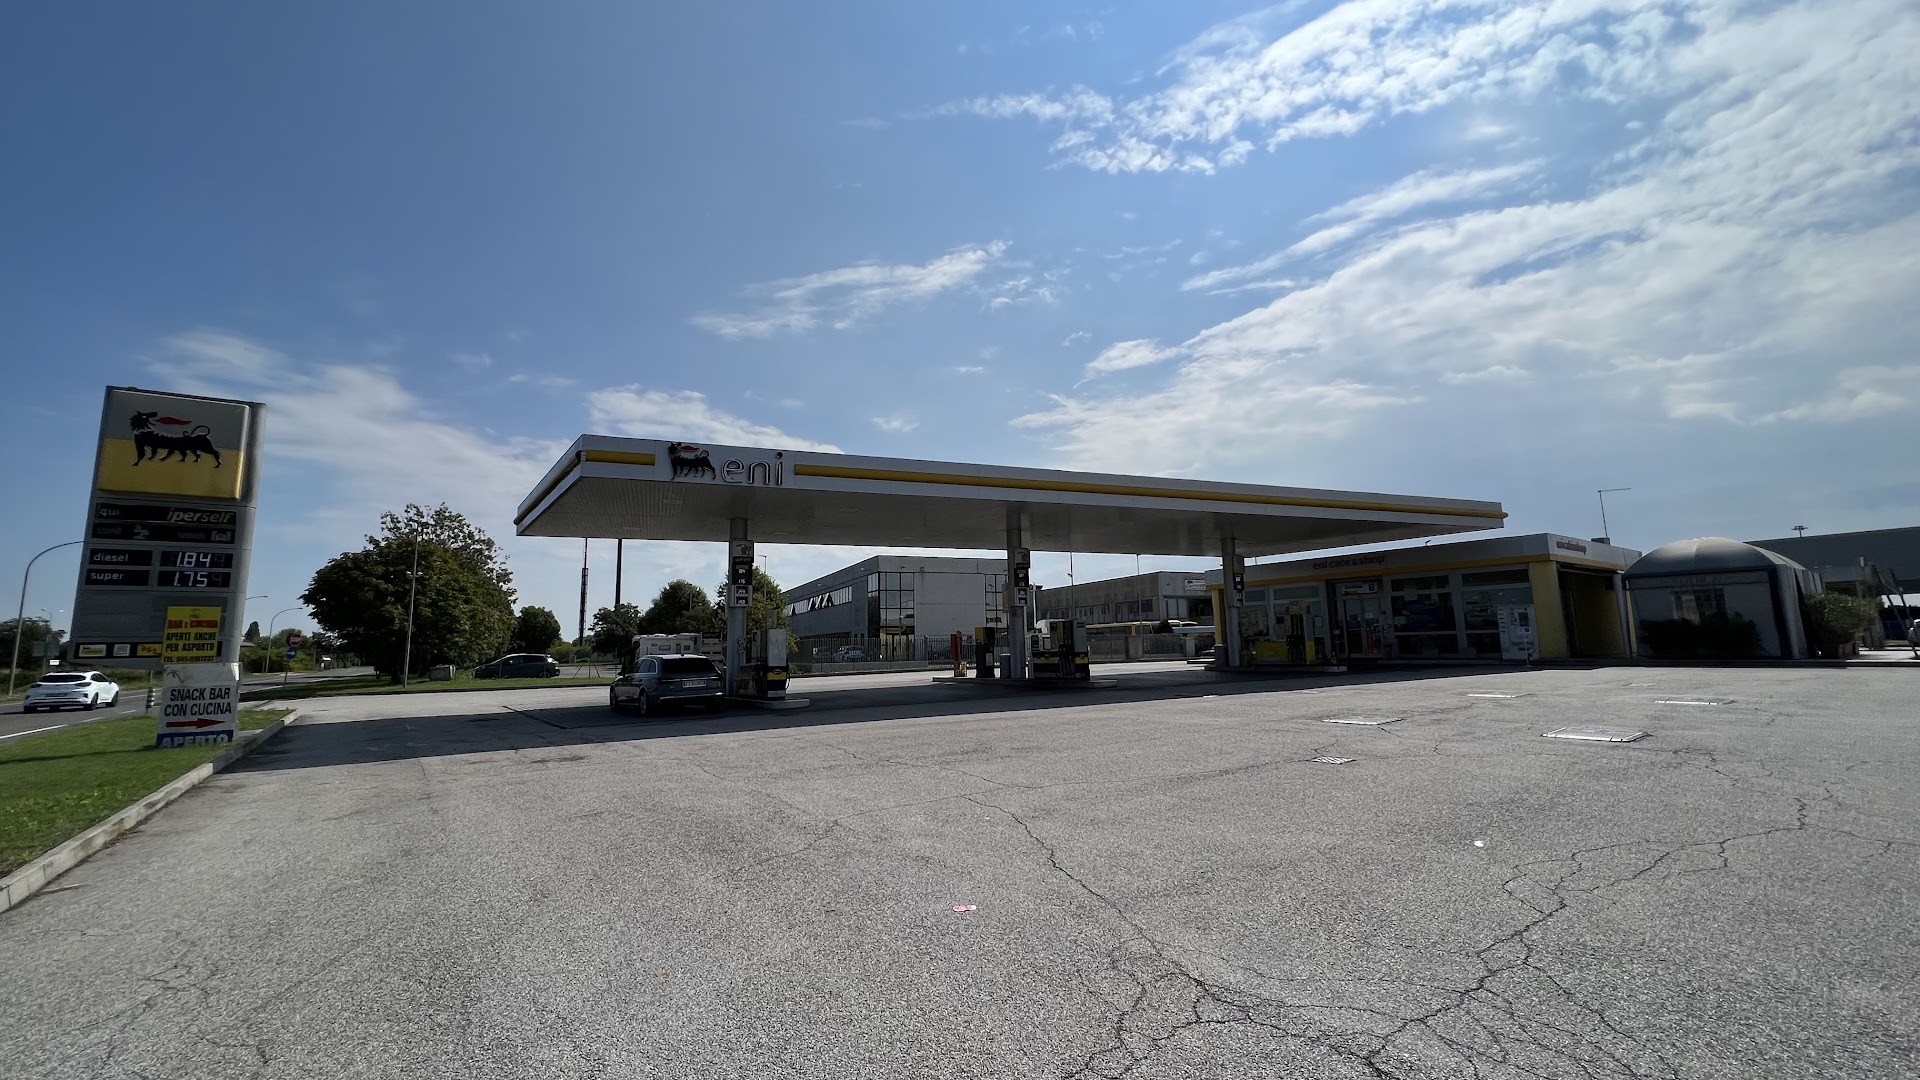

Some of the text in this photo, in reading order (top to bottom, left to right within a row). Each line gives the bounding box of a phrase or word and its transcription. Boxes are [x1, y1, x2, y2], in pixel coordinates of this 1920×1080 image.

[721, 451, 783, 486] eni
[99, 508, 233, 523] qui iperself
[93, 553, 129, 562] diesel
[90, 572, 125, 582] super
[165, 632, 216, 641] APERTI ANCHE
[165, 643, 214, 652] PER ASPORTO
[170, 687, 231, 702] SNACK BAR
[164, 702, 232, 717] CON CUCINA
[159, 734, 229, 748] APERTO
